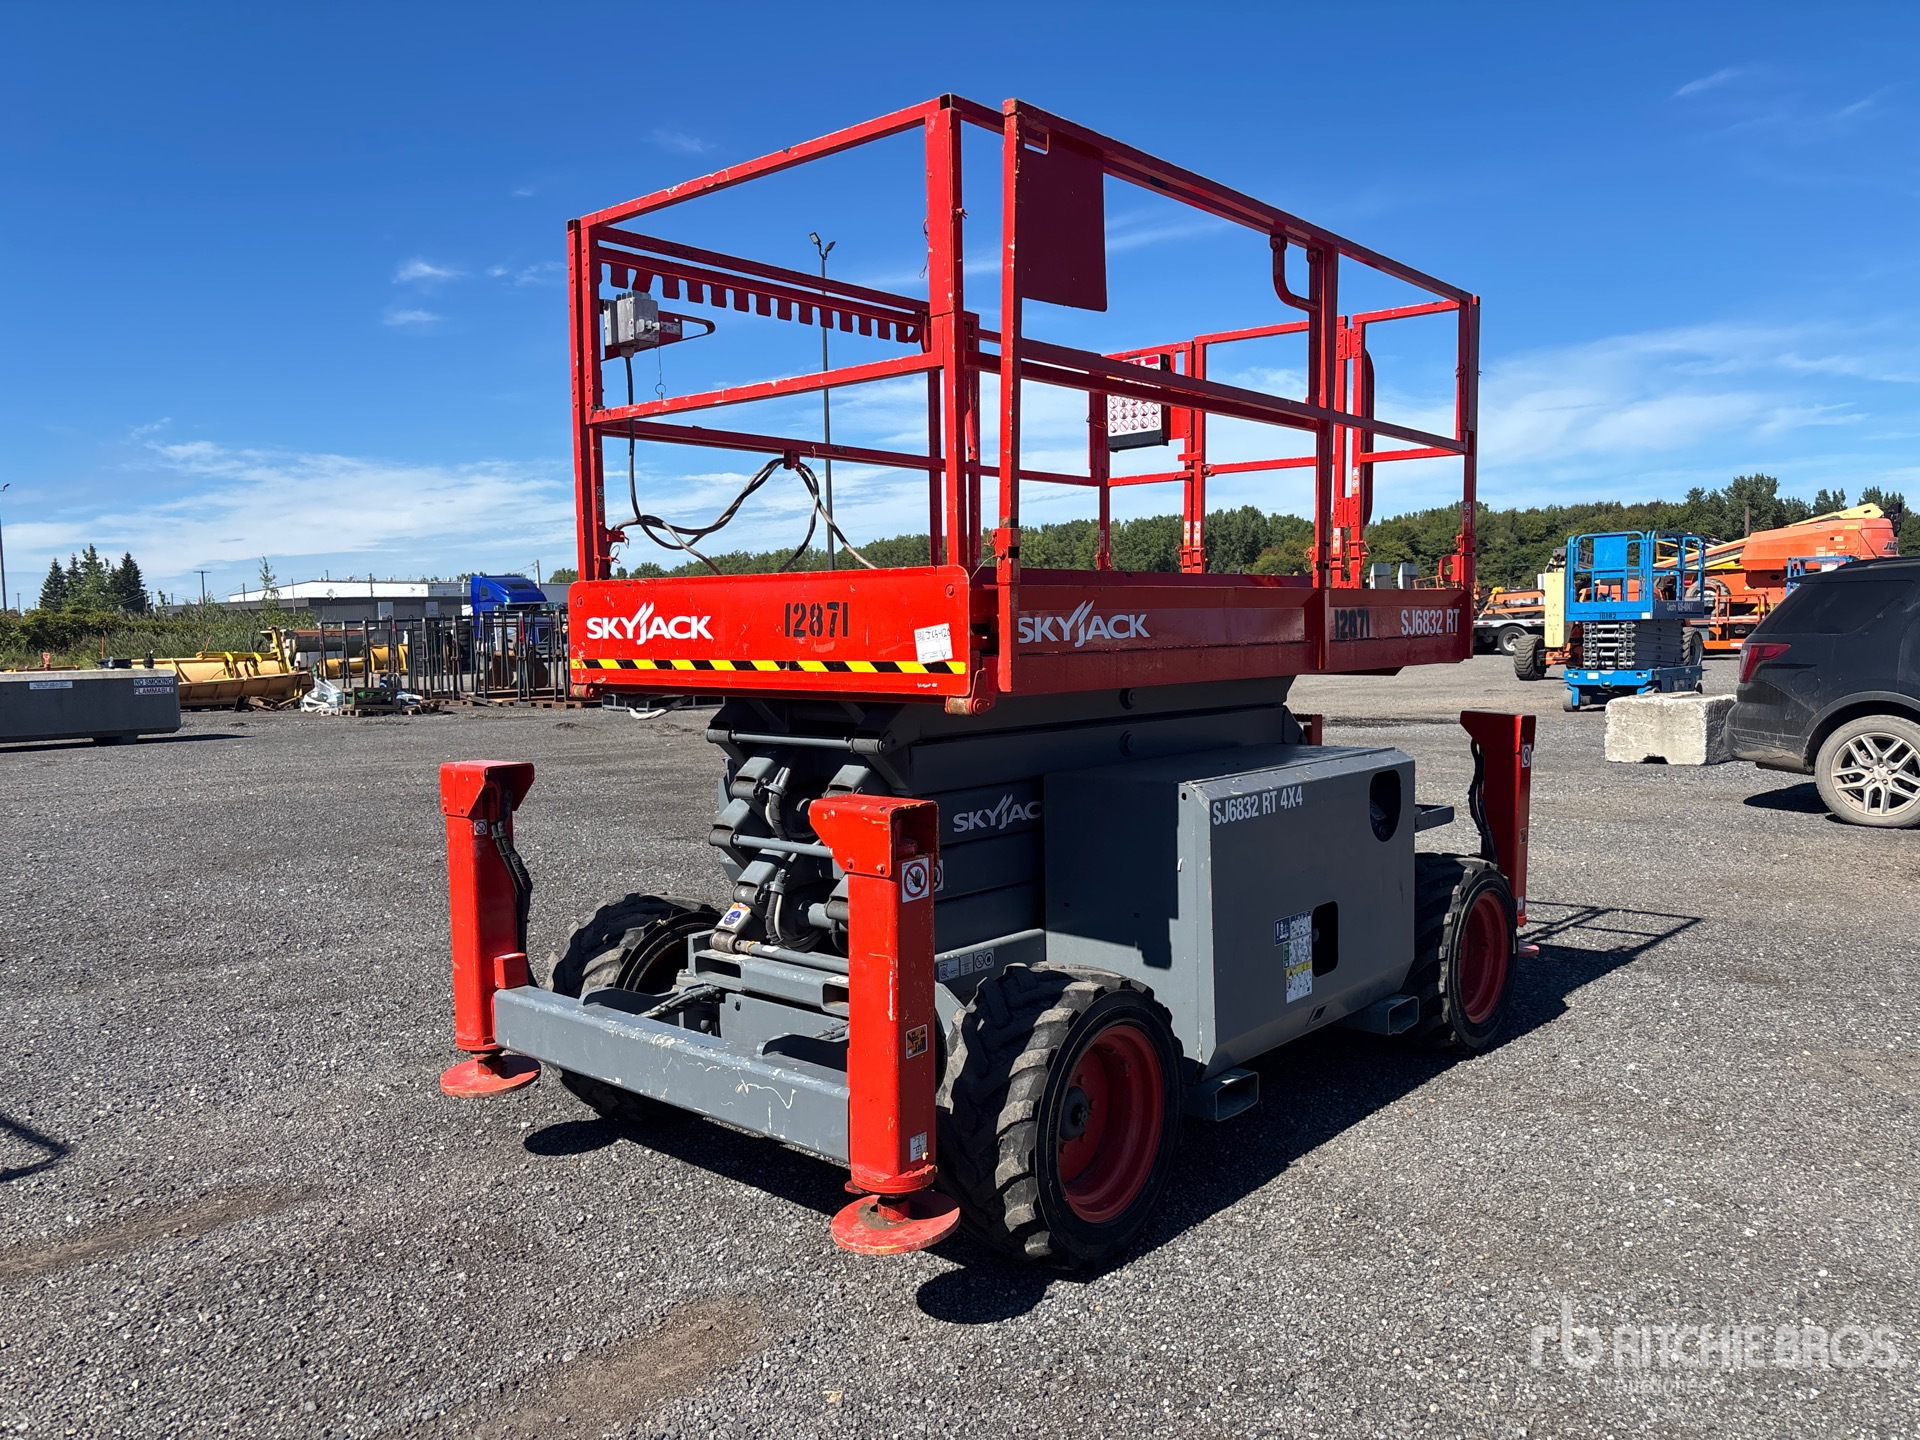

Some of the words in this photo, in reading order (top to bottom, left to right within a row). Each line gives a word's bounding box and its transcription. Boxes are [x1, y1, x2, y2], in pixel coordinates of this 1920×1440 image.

[586, 602, 713, 645] SKYJACK
[784, 602, 849, 638] 12871
[1018, 599, 1150, 648] SKYJACK
[1334, 608, 1370, 639] 12871
[1400, 608, 1443, 636] SJ6832
[1445, 608, 1461, 634] RT
[134, 678, 145, 686] NO
[145, 678, 173, 686] SMOKING
[134, 687, 174, 695] FLAMMABLE
[953, 793, 1044, 833] SKYJAC
[1212, 789, 1260, 826] SJ6832
[1262, 788, 1279, 816] RT
[1280, 785, 1304, 810] 4X4
